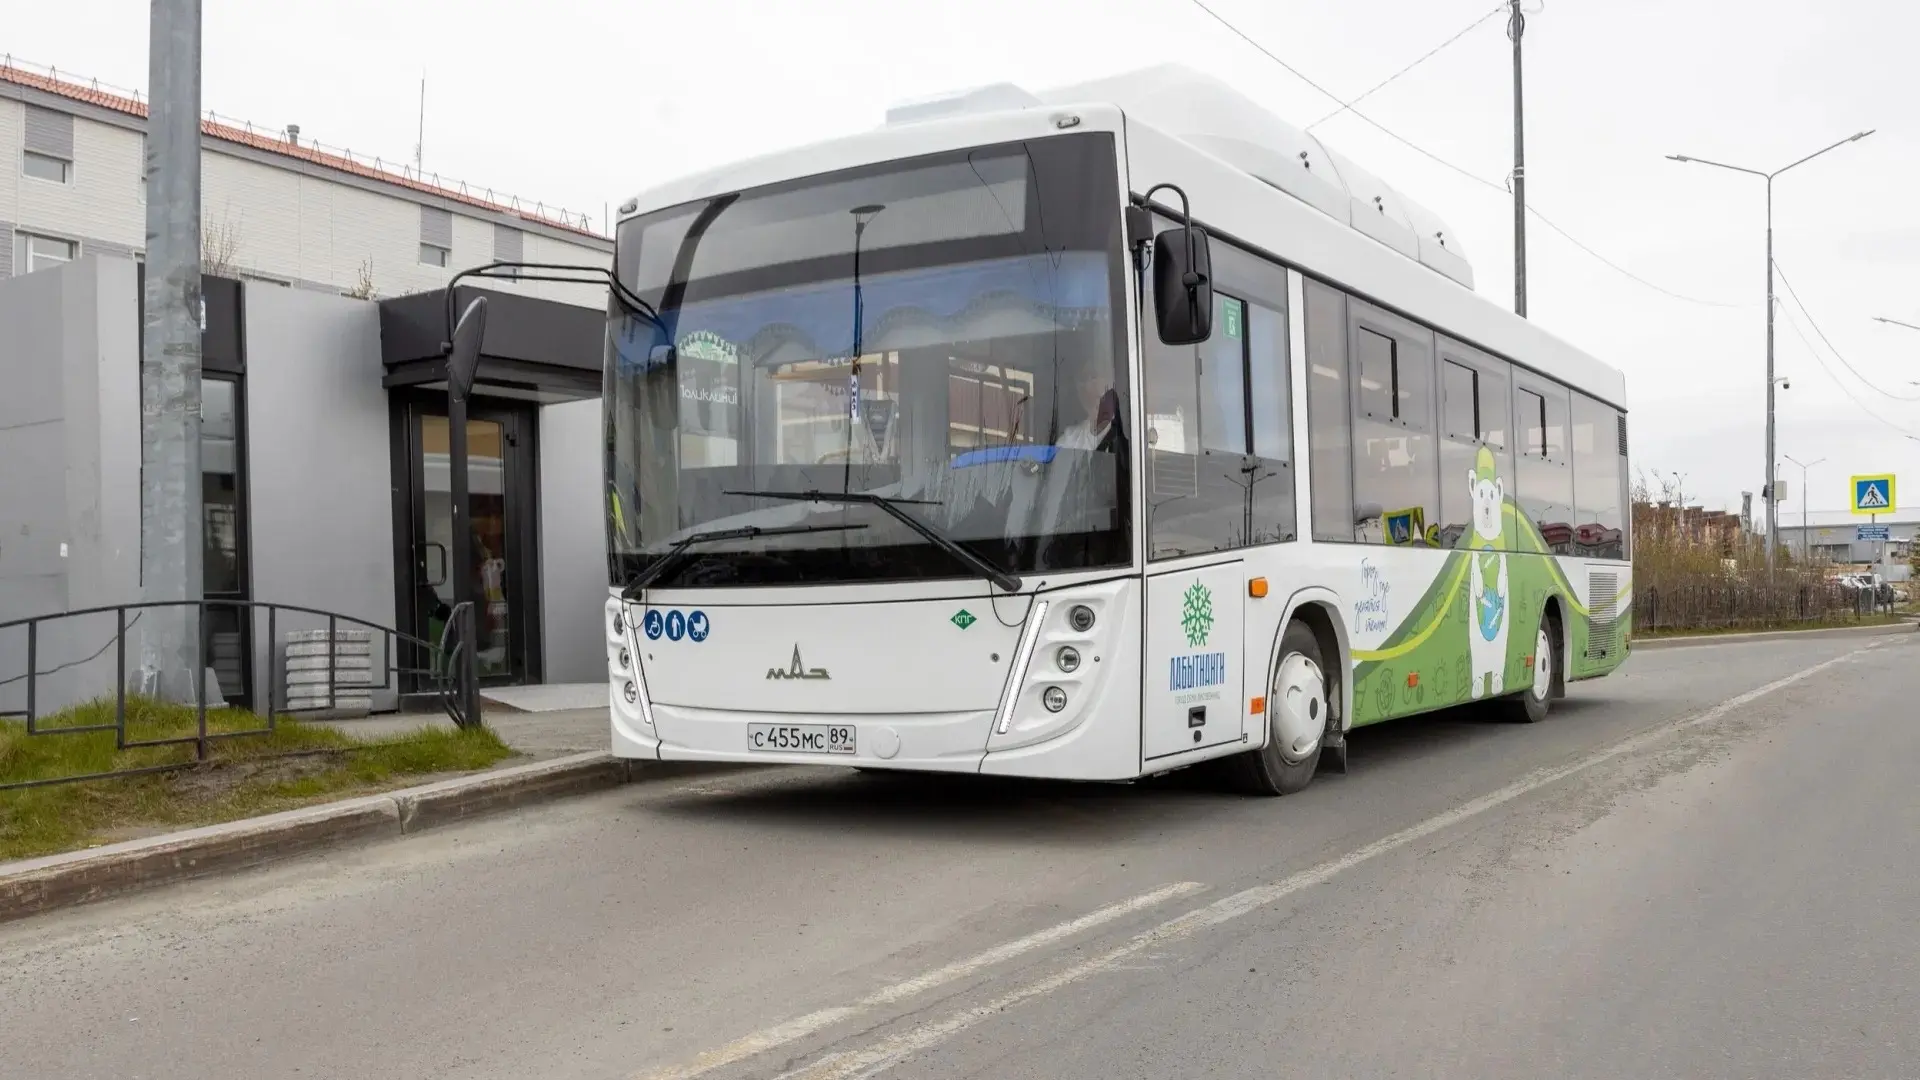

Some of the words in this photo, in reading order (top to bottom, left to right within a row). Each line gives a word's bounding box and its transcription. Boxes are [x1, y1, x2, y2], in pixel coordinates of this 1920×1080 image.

[954, 615, 972, 624] КПГ
[766, 643, 830, 680] МАЗ
[1169, 652, 1225, 691] ЛАБЫТНАНГИ
[830, 728, 848, 744] 89
